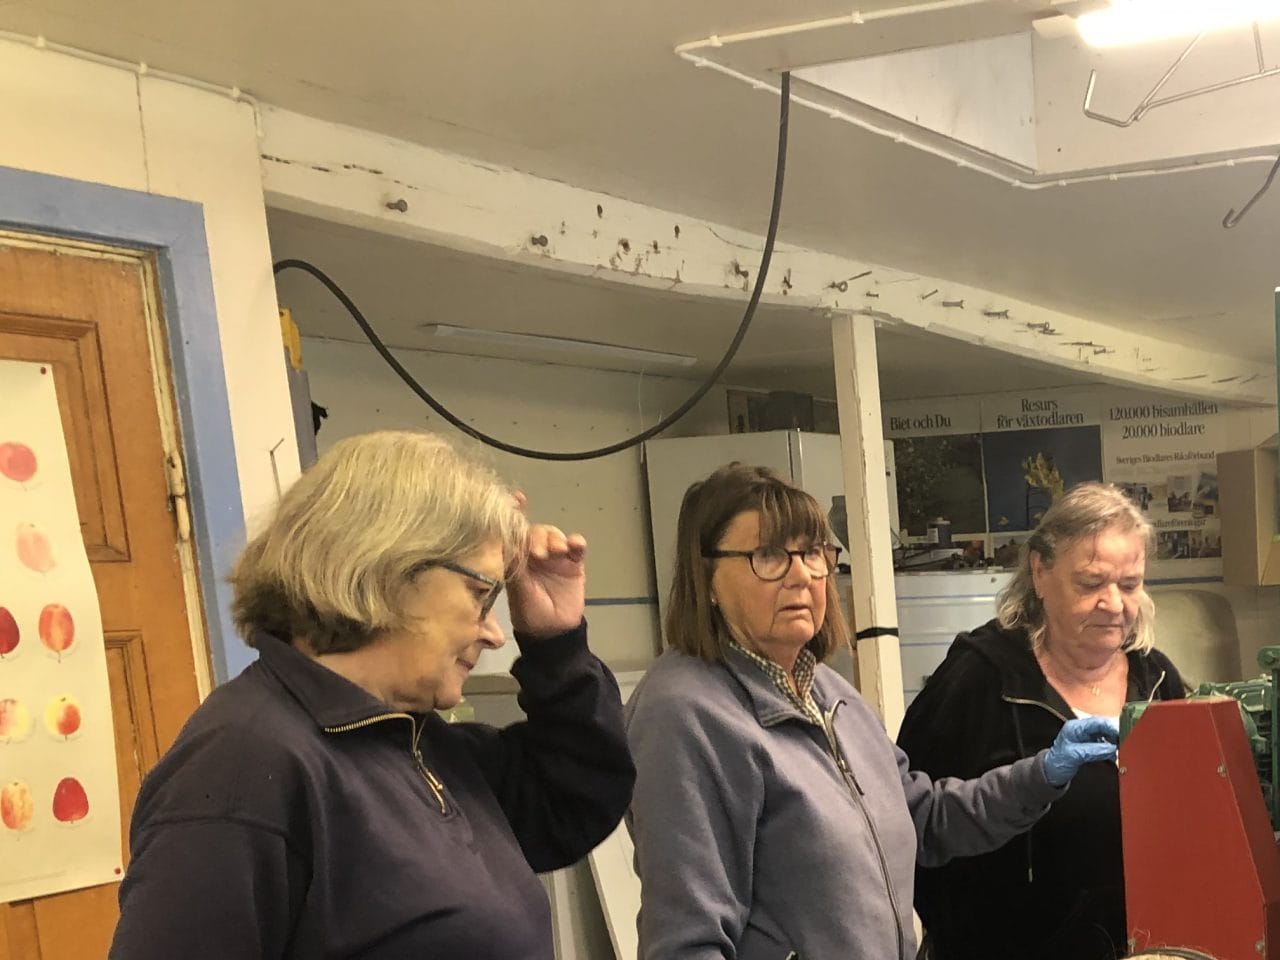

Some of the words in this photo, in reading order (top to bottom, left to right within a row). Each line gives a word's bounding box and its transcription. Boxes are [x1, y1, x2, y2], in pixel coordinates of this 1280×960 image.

[1021, 398, 1058, 413] Resurs
[1152, 401, 1218, 419] bisamhällen
[890, 416, 911, 431] Biet
[913, 413, 934, 429] och
[935, 413, 952, 428] Du
[997, 413, 1014, 429] för
[1016, 411, 1084, 428] växtodlaren
[1160, 421, 1205, 437] biodlare
